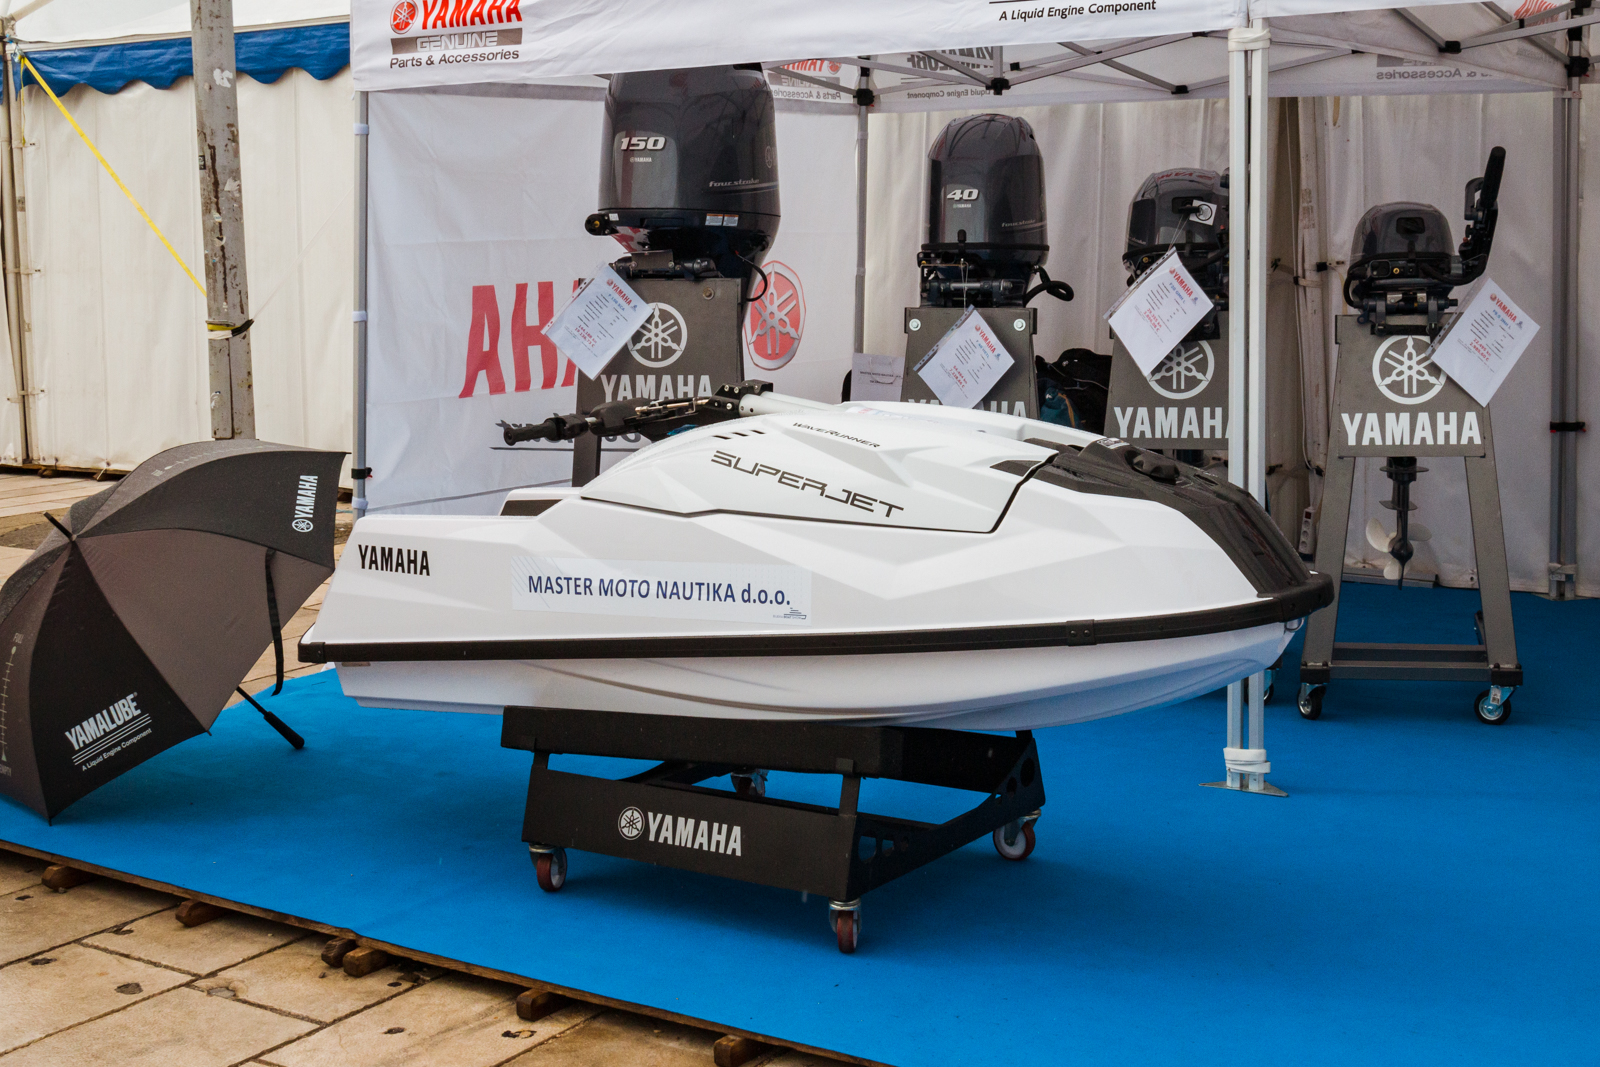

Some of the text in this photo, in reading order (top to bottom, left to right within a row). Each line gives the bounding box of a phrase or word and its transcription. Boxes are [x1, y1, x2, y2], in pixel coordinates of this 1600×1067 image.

[421, 0, 523, 30] YAMAHA
[999, 0, 1157, 22] A Liquid Engine Component
[416, 31, 498, 52] GENUINE
[390, 48, 520, 69] Parts & Accessories
[621, 136, 667, 151] 150
[947, 188, 979, 201] 40
[610, 283, 632, 305] YAMAHA
[1172, 271, 1194, 297] YAMAHA
[1493, 298, 1518, 322] YAMAHA
[977, 330, 997, 353] YAMAHA
[600, 375, 713, 401] YAMAHA
[1114, 407, 1229, 439] YAMAH
[1341, 411, 1482, 446] YAMAHA
[294, 475, 319, 518] YAMAHA
[358, 544, 430, 577] YAMAHA
[528, 575, 791, 605] MASTER MOTO NAUTIKA d.o.o.
[64, 692, 142, 751] YAMALUBE
[86, 755, 104, 769] Liquid
[102, 745, 121, 759] Engine
[121, 727, 152, 748] Component
[647, 811, 742, 857] YAMAHA
